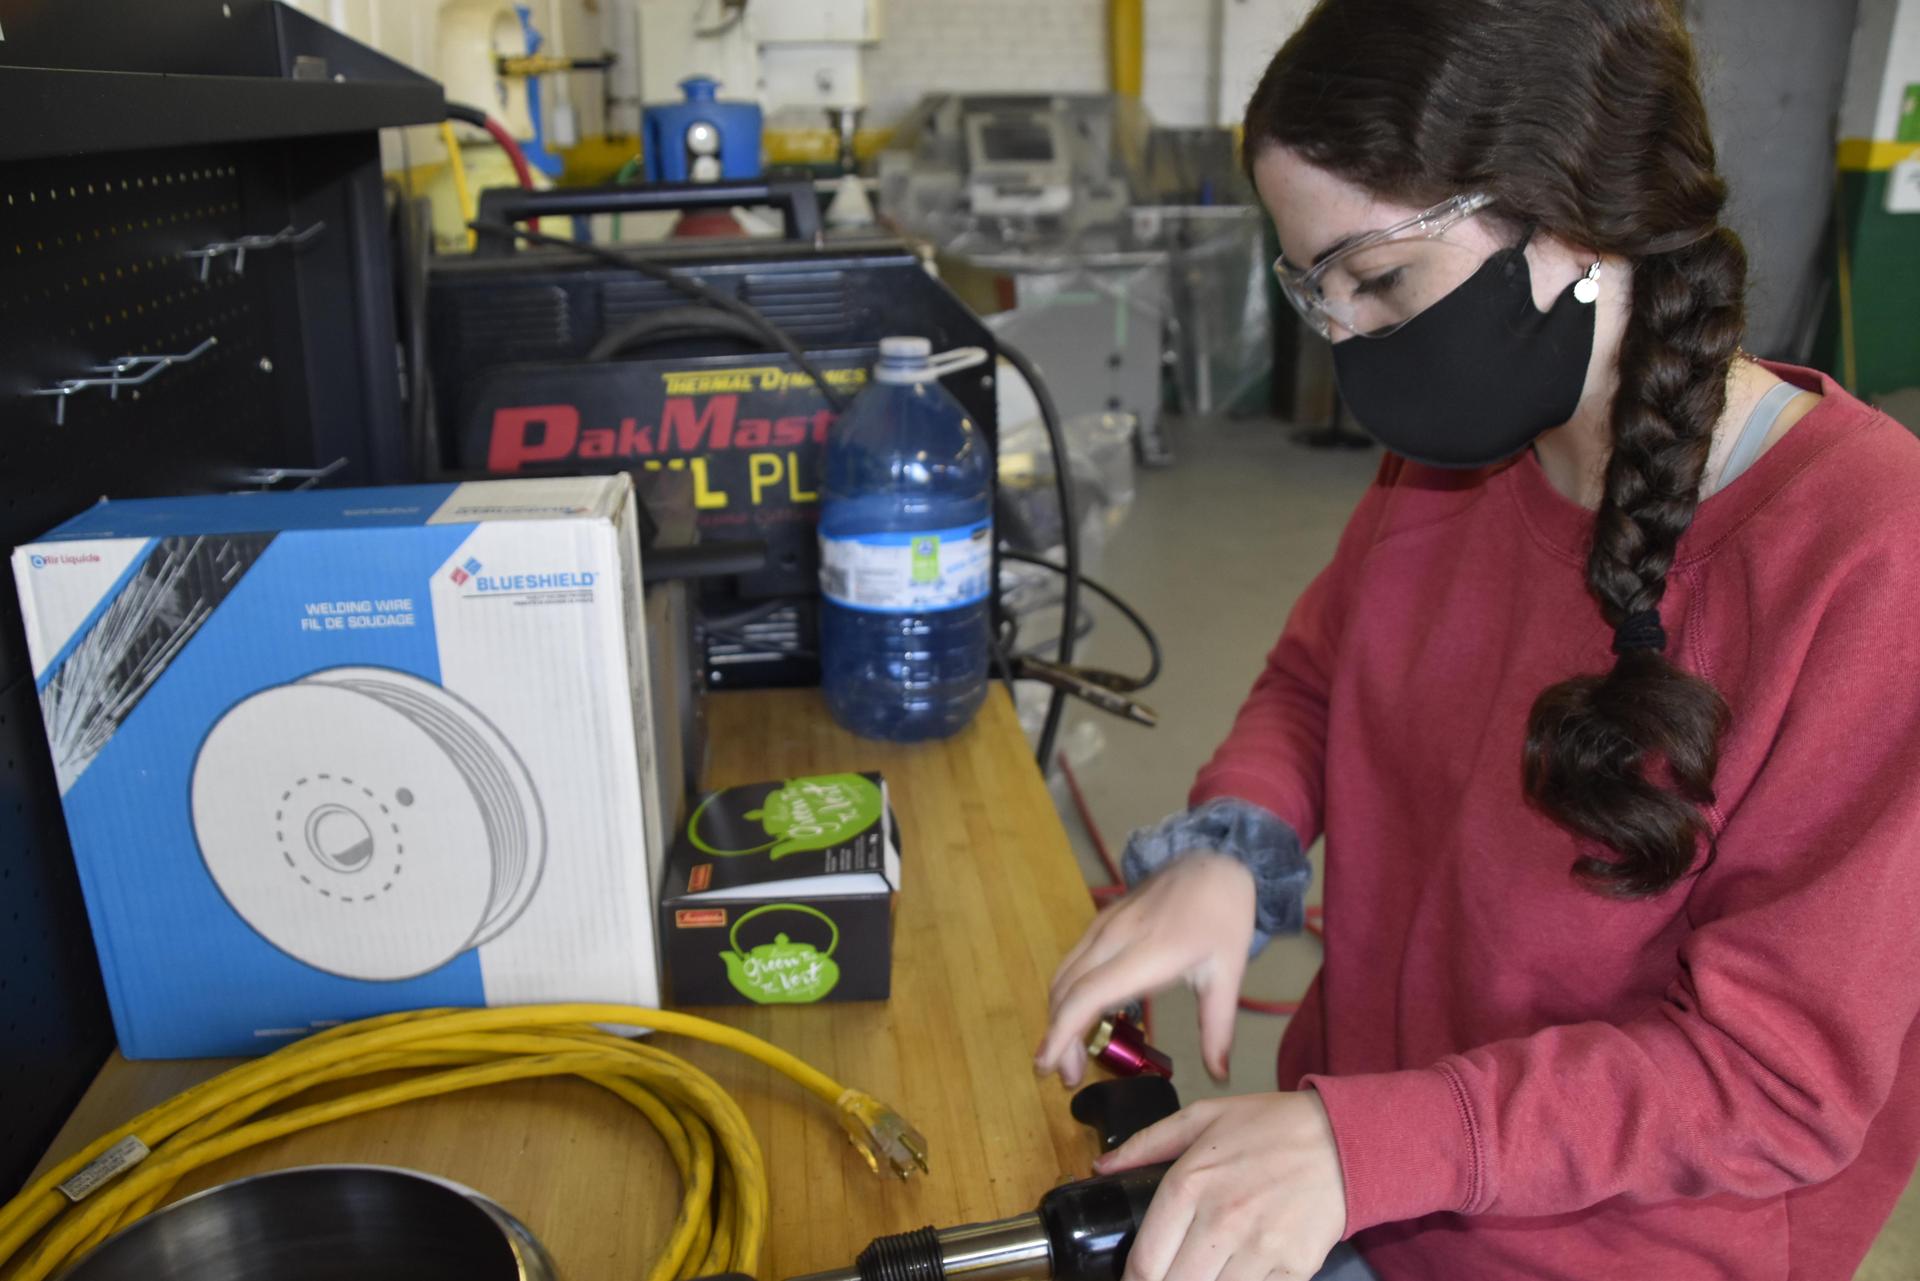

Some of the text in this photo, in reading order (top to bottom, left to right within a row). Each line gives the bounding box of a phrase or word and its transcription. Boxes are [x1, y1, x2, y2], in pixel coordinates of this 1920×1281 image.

[662, 368, 754, 395] THERMAL
[487, 394, 839, 473] PakMast
[749, 452, 818, 505] PL
[476, 572, 594, 592] BLUESHIELD
[304, 598, 414, 616] WELDING WIRE
[300, 614, 416, 632] FIL DE SOUDAGE
